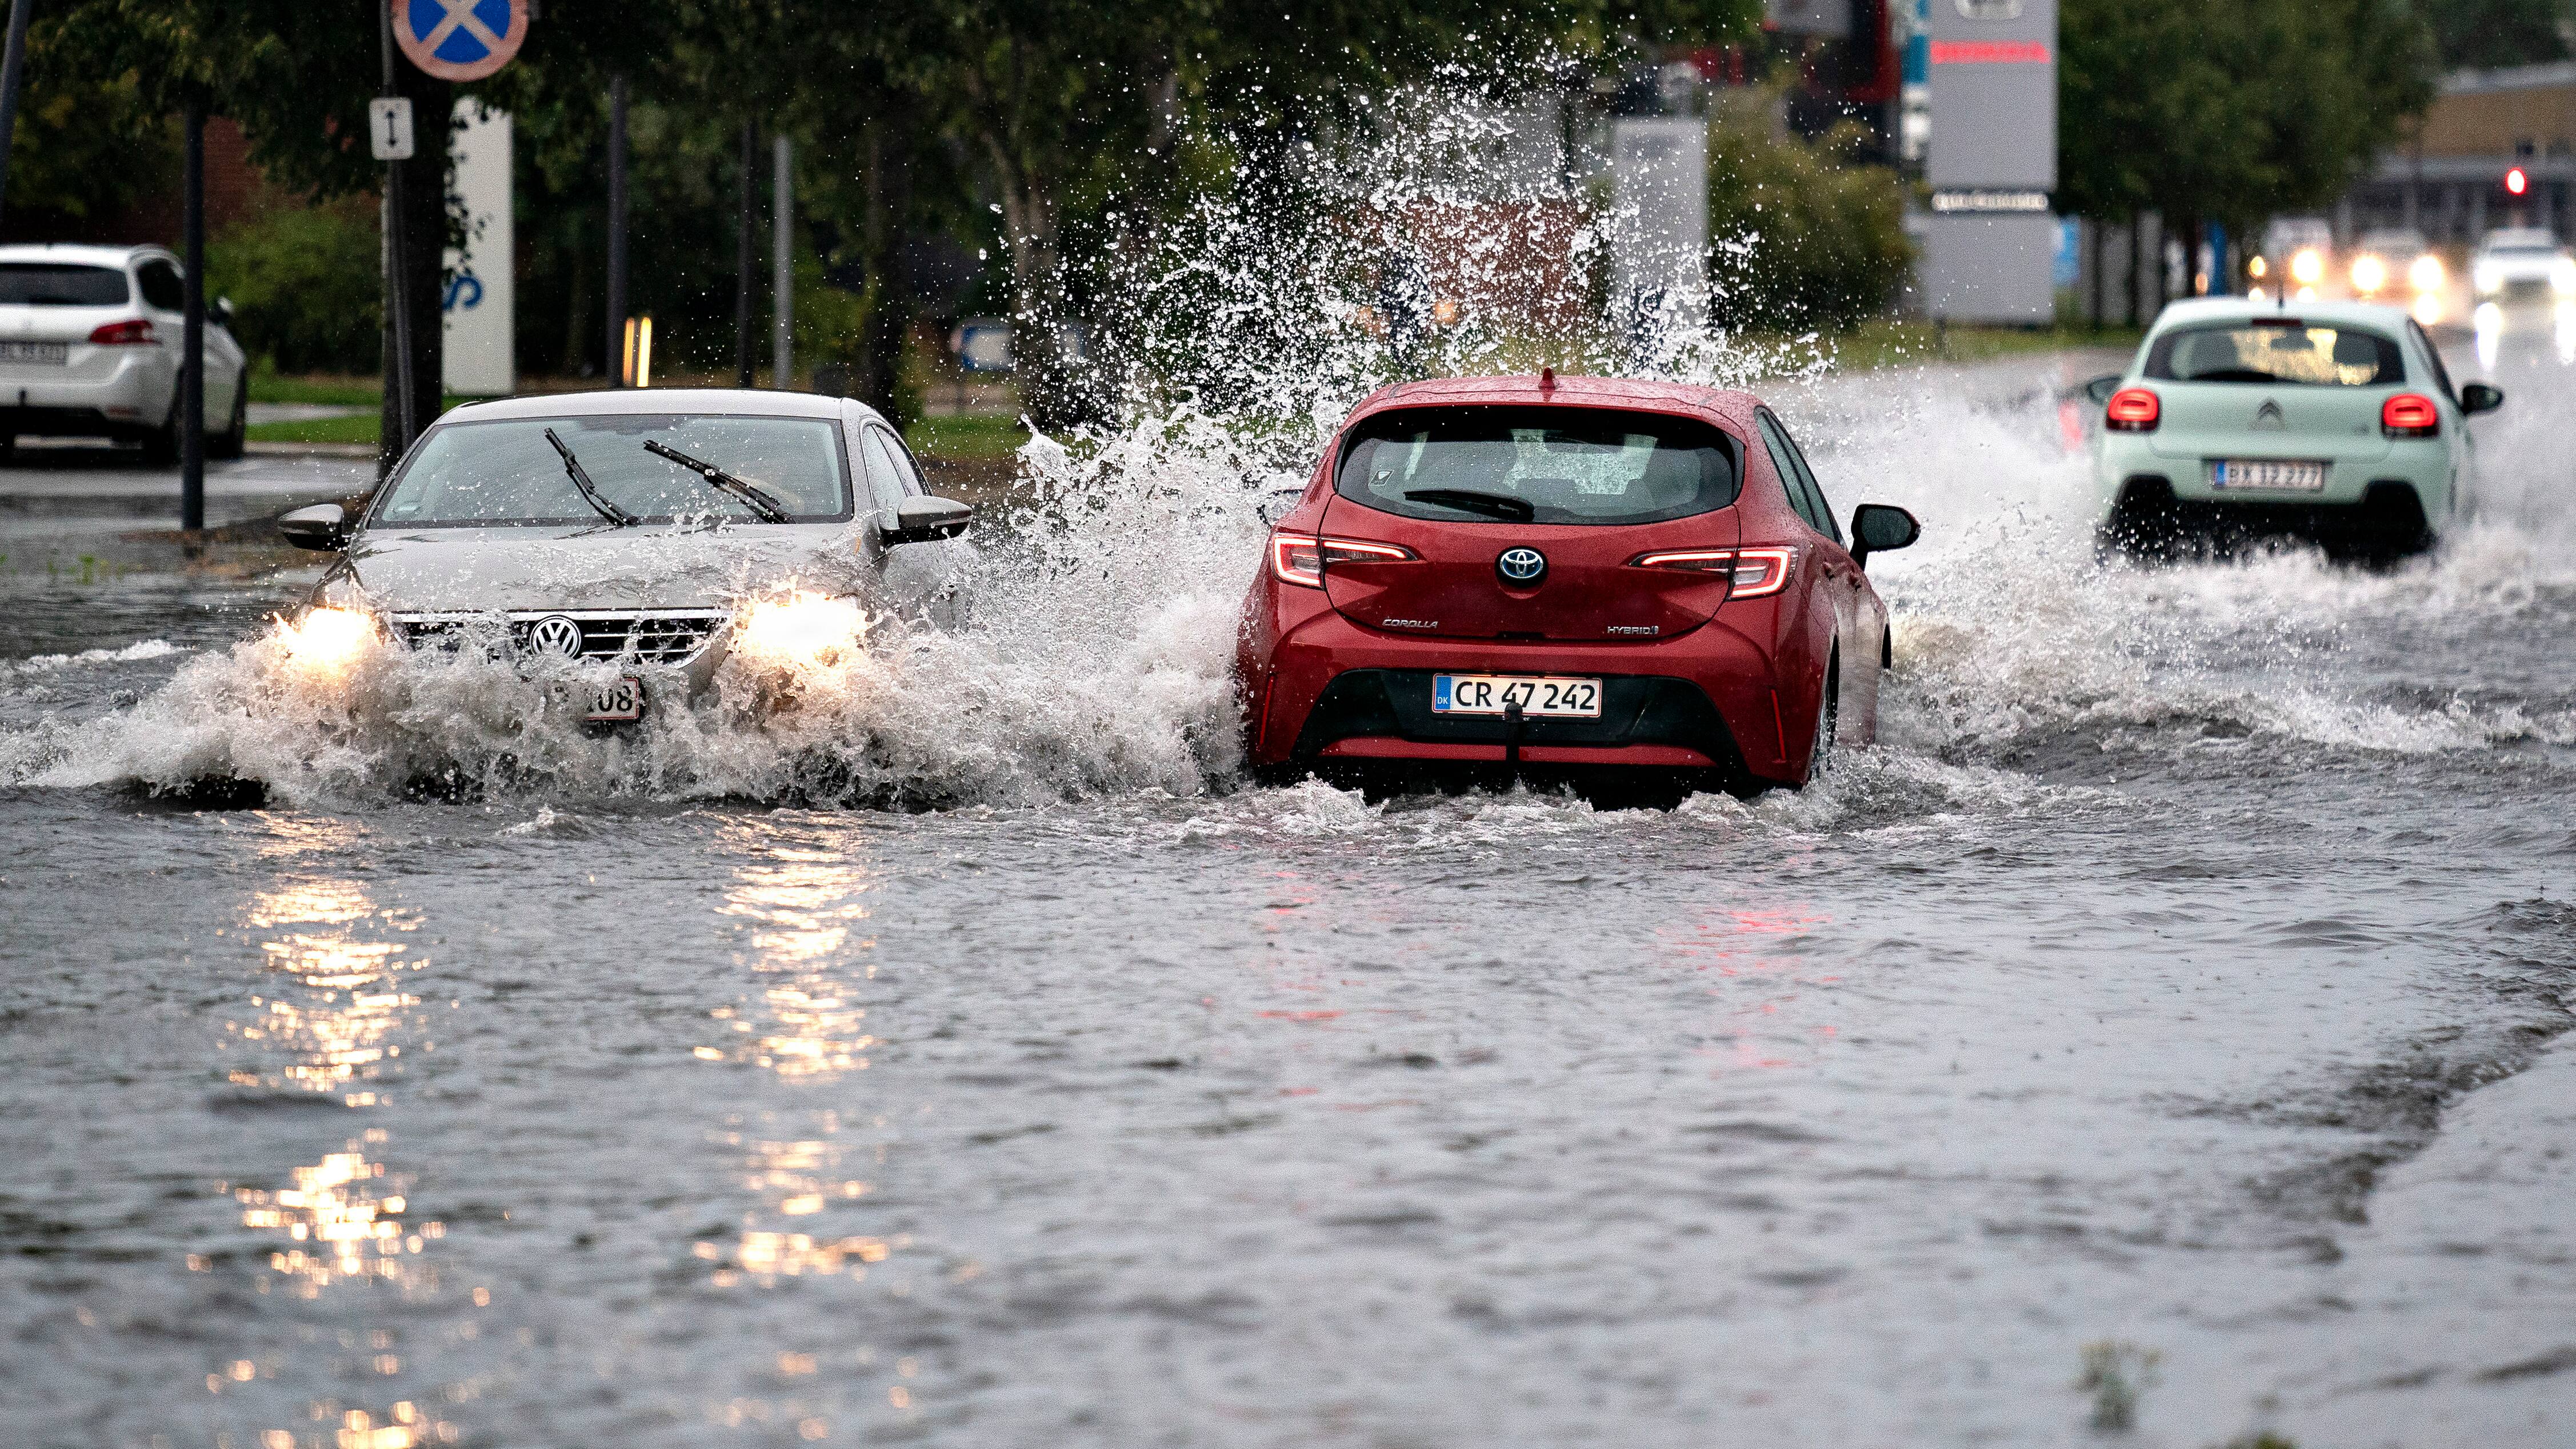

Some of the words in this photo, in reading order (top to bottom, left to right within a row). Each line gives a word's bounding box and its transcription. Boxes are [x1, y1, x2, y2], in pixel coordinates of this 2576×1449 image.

[1382, 619, 1438, 629] COROLLA
[1607, 626, 1650, 635] HYBRID
[586, 685, 633, 712] 08
[1437, 696, 1449, 705] DK
[1455, 681, 1492, 707] CR
[1501, 682, 1536, 708] 47
[1543, 684, 1595, 710] 242
